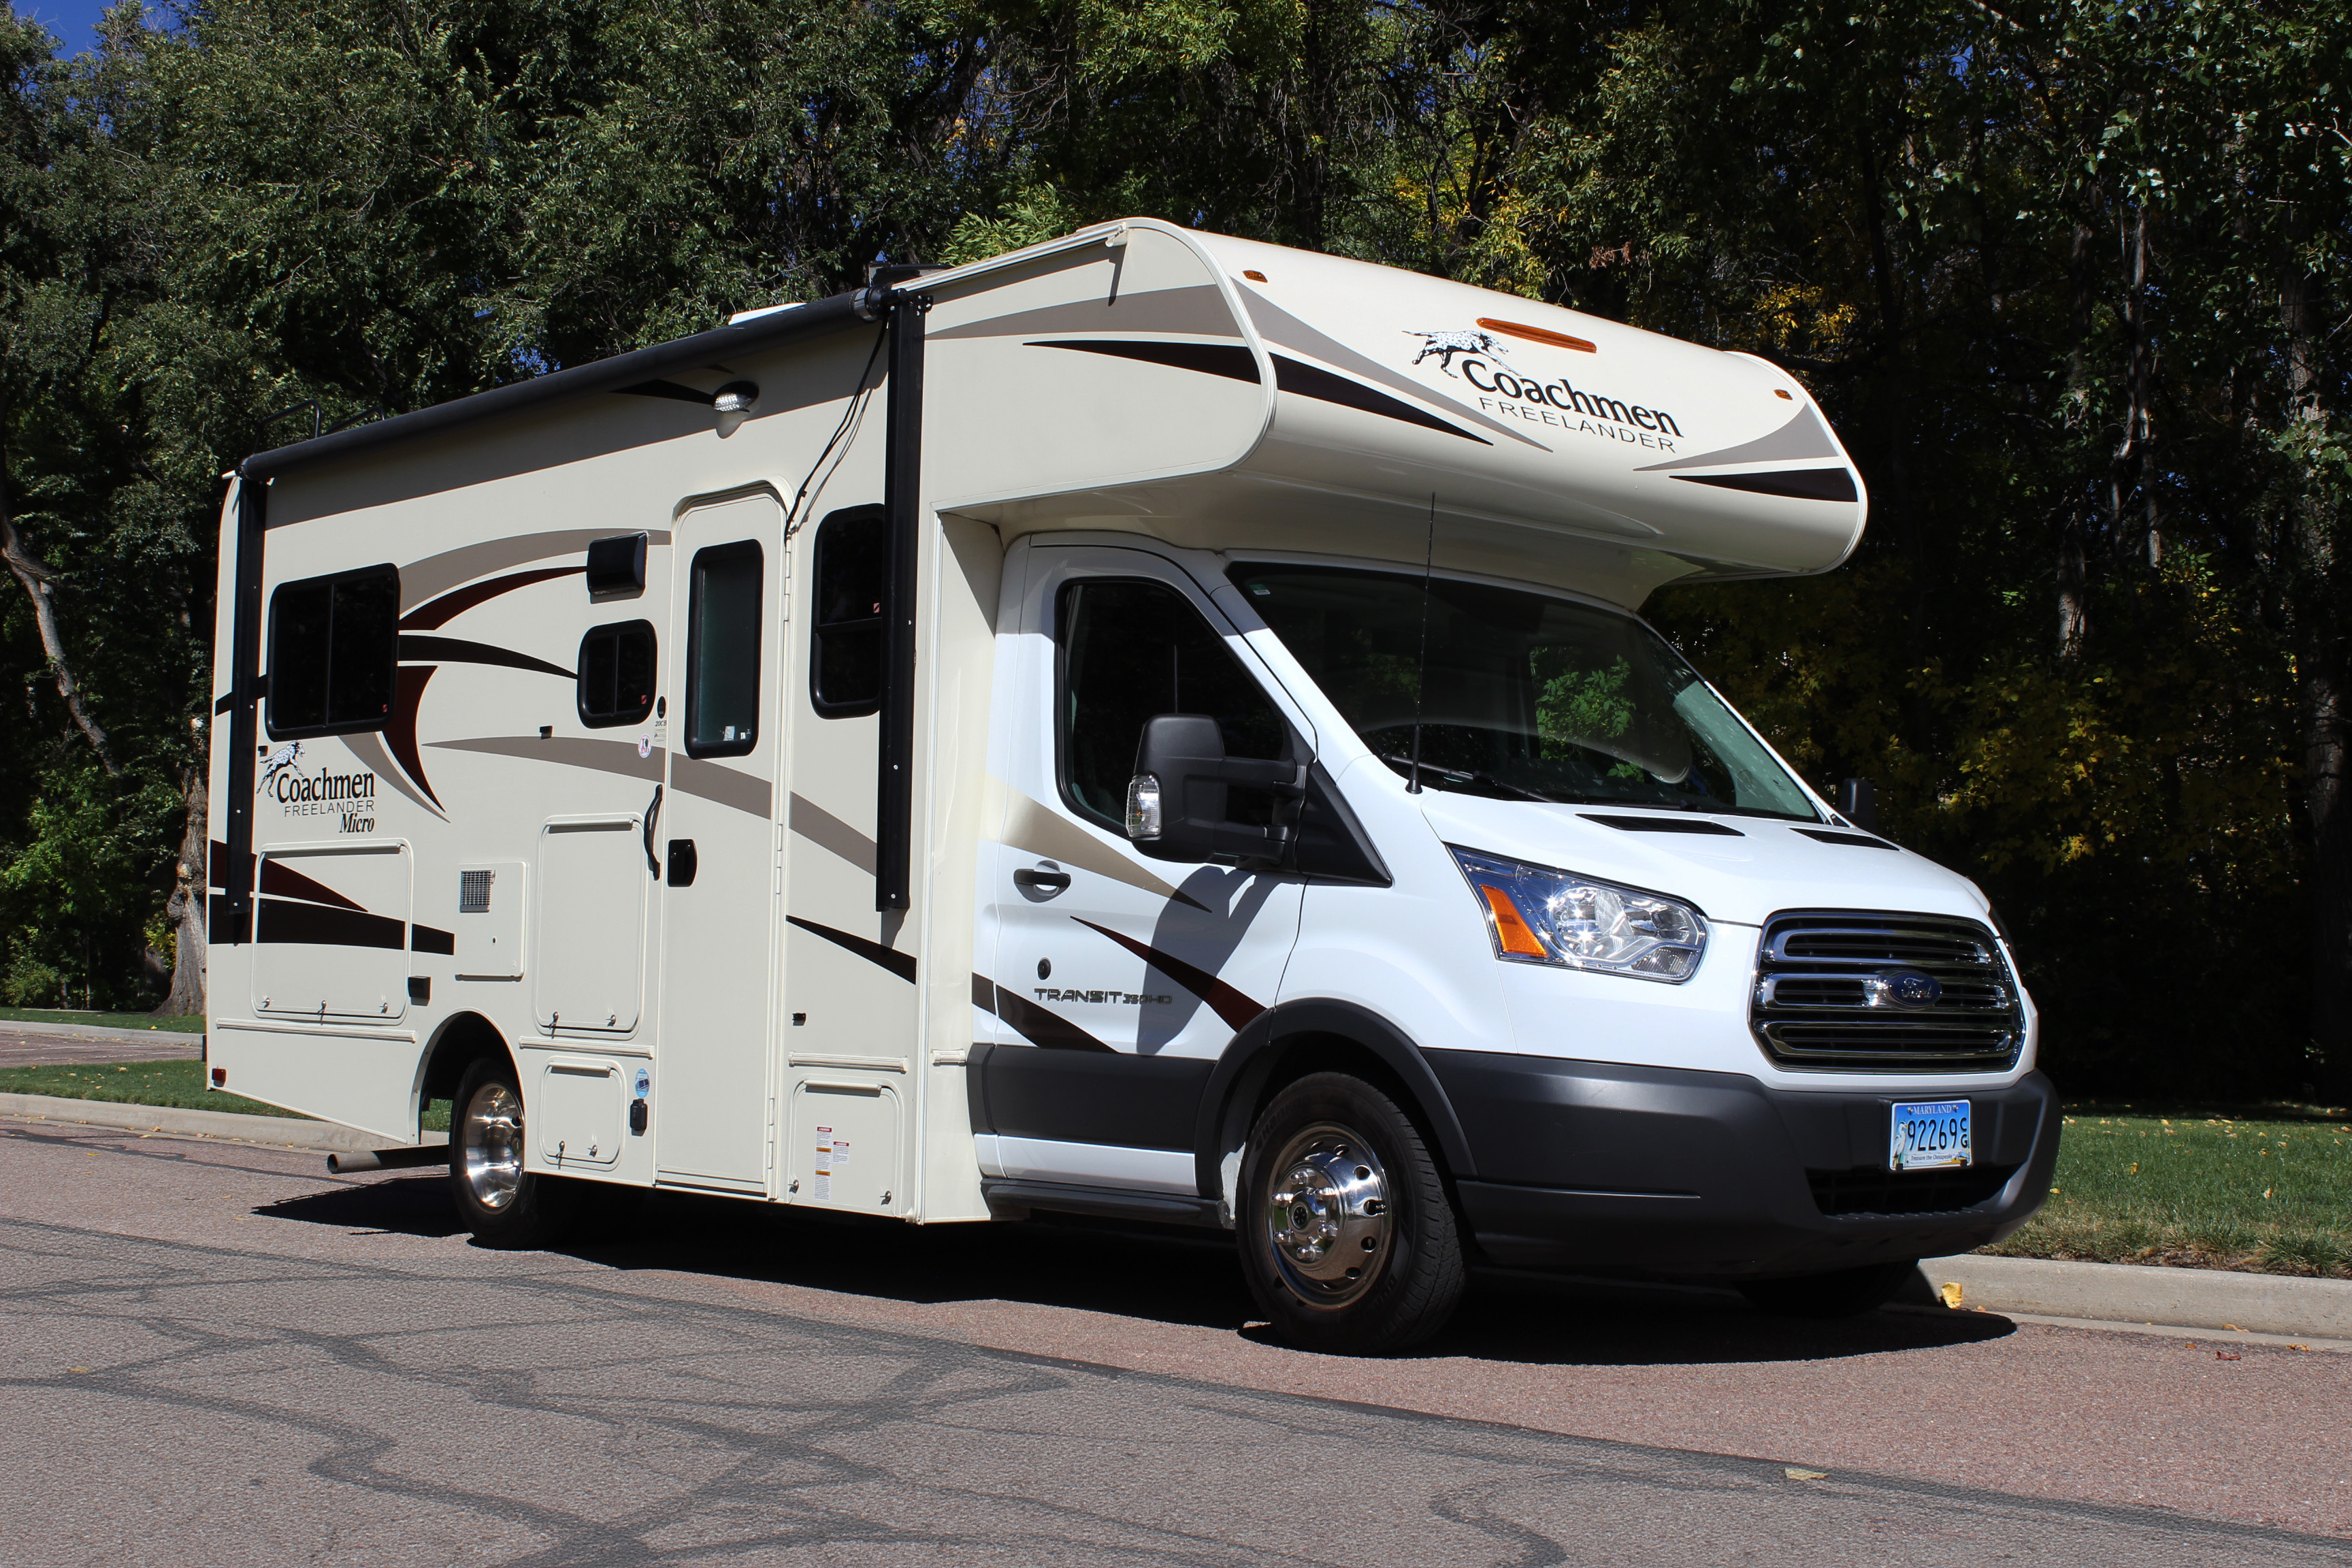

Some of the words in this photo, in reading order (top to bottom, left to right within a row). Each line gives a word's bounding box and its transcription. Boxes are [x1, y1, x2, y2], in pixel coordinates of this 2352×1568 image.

[1462, 359, 1684, 438] Coachmen
[1478, 397, 1676, 454] FREELANDER
[276, 767, 375, 803] Coachmen
[284, 800, 374, 817] FREELANDER
[339, 813, 375, 833] Micro
[1034, 988, 1122, 1004] TRANSIT
[1901, 977, 1933, 999] Ford
[1913, 1104, 1952, 1115] MARYLAND
[1908, 1117, 1957, 1152] 92269
